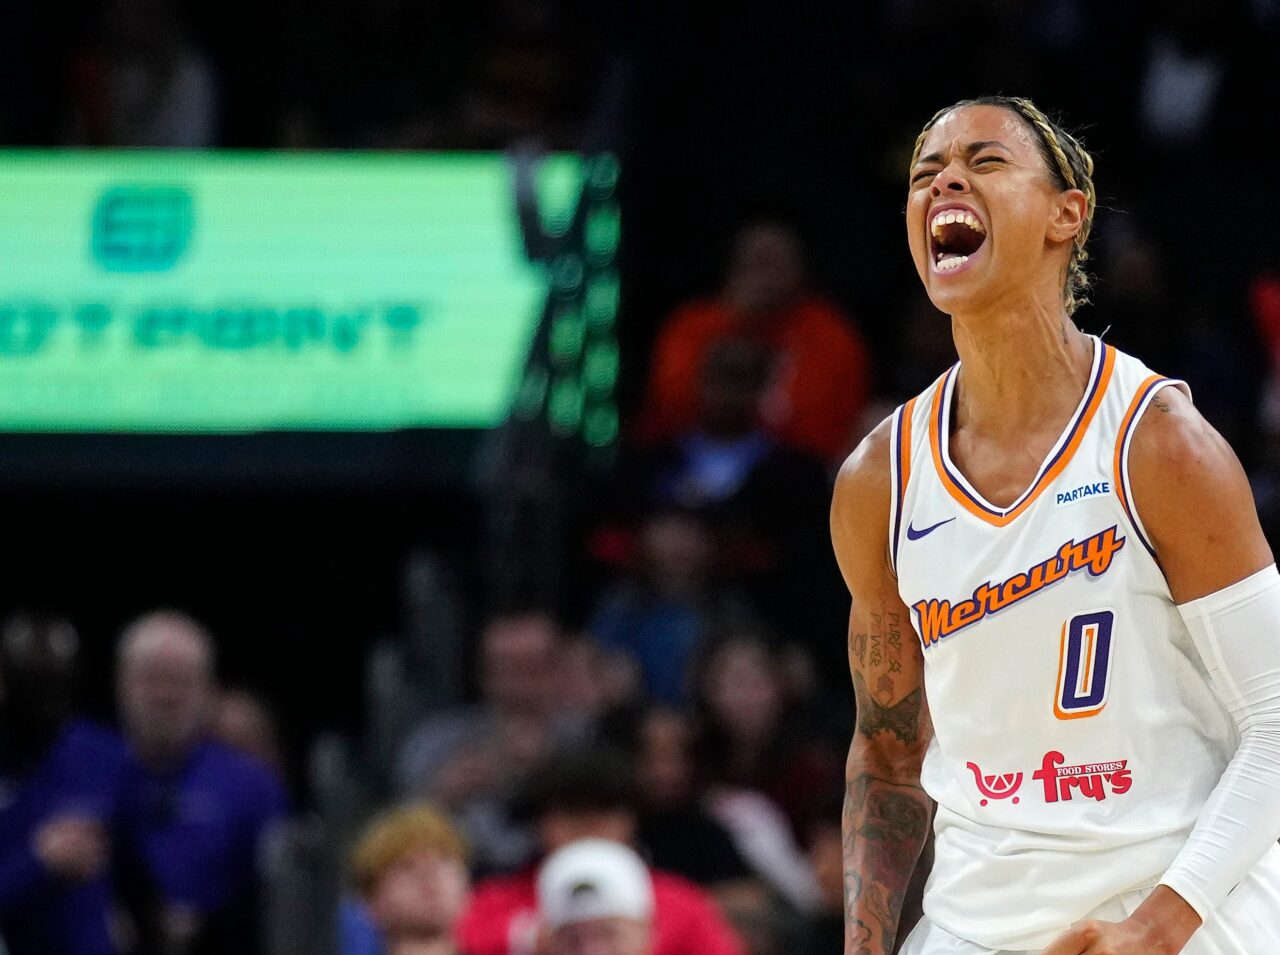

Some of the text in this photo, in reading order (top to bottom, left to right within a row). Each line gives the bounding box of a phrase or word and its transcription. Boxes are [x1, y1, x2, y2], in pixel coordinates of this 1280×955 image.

[1056, 482, 1110, 504] PARTAKE
[911, 524, 1126, 649] Mercury
[1053, 607, 1117, 720] 0
[1057, 761, 1123, 777] FOOD STORES
